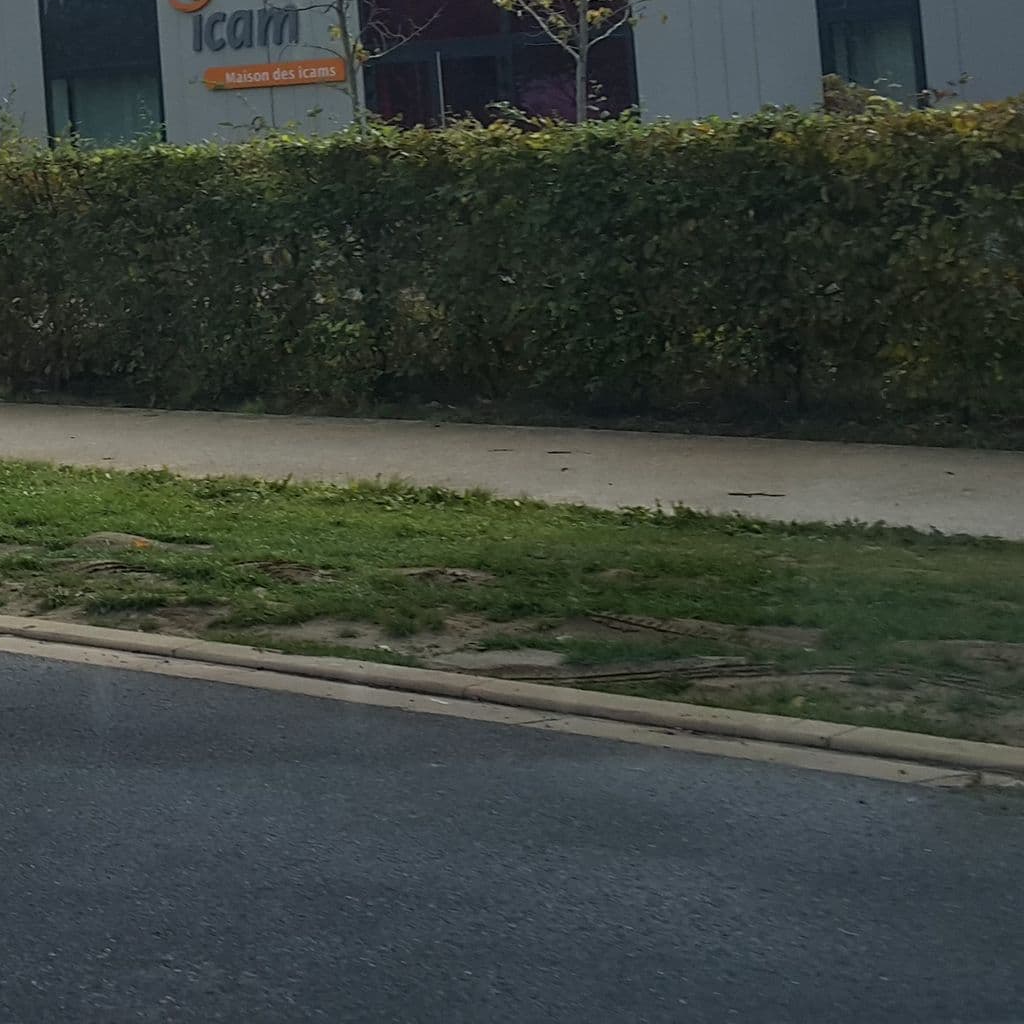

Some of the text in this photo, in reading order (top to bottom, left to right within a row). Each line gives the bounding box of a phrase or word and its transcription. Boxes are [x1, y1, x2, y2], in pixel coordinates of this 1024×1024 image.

[192, 5, 300, 52] icam
[225, 70, 270, 83] Maison
[272, 67, 295, 80] des
